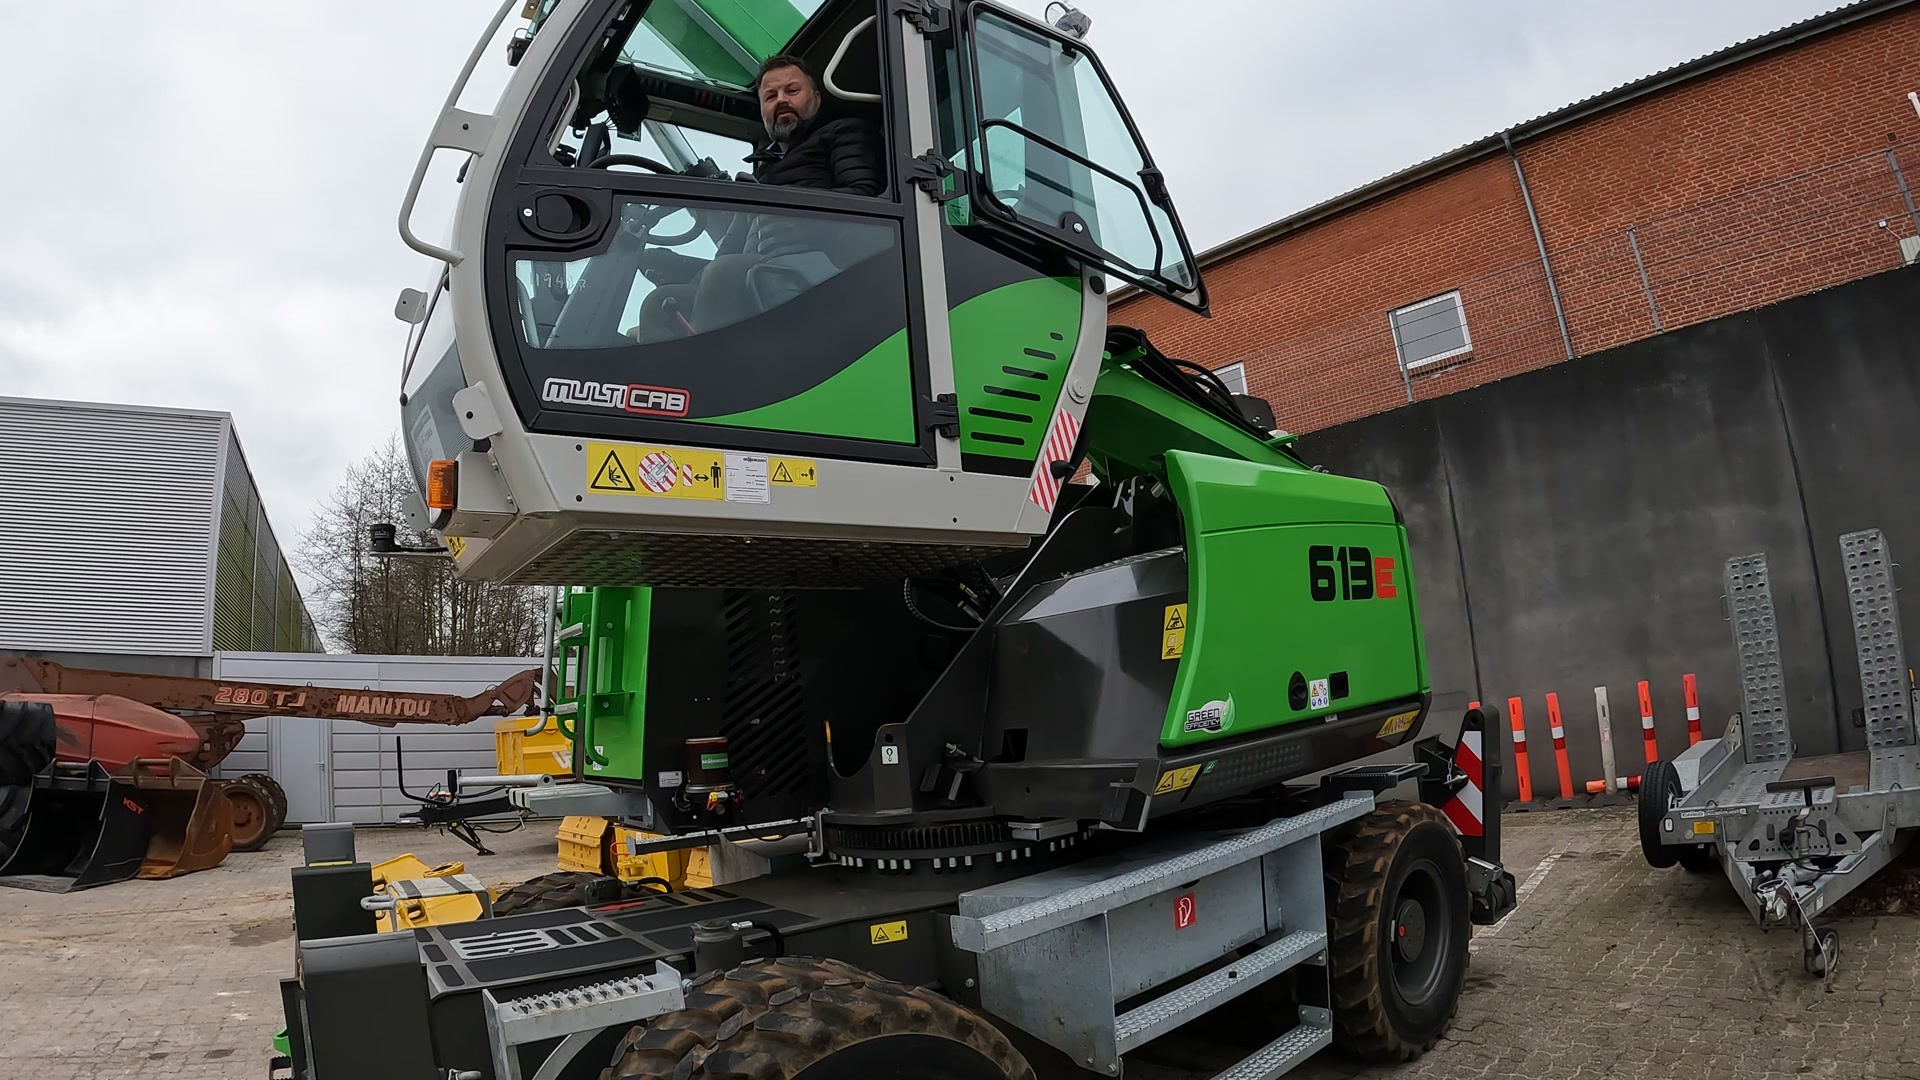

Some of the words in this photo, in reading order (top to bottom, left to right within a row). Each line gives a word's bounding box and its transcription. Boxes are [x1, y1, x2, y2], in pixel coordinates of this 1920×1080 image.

[541, 377, 691, 417] MULTICAB
[214, 687, 268, 705] 280
[272, 690, 307, 708] TJ
[336, 694, 431, 717] MANITOU
[1188, 708, 1220, 722] GREEN
